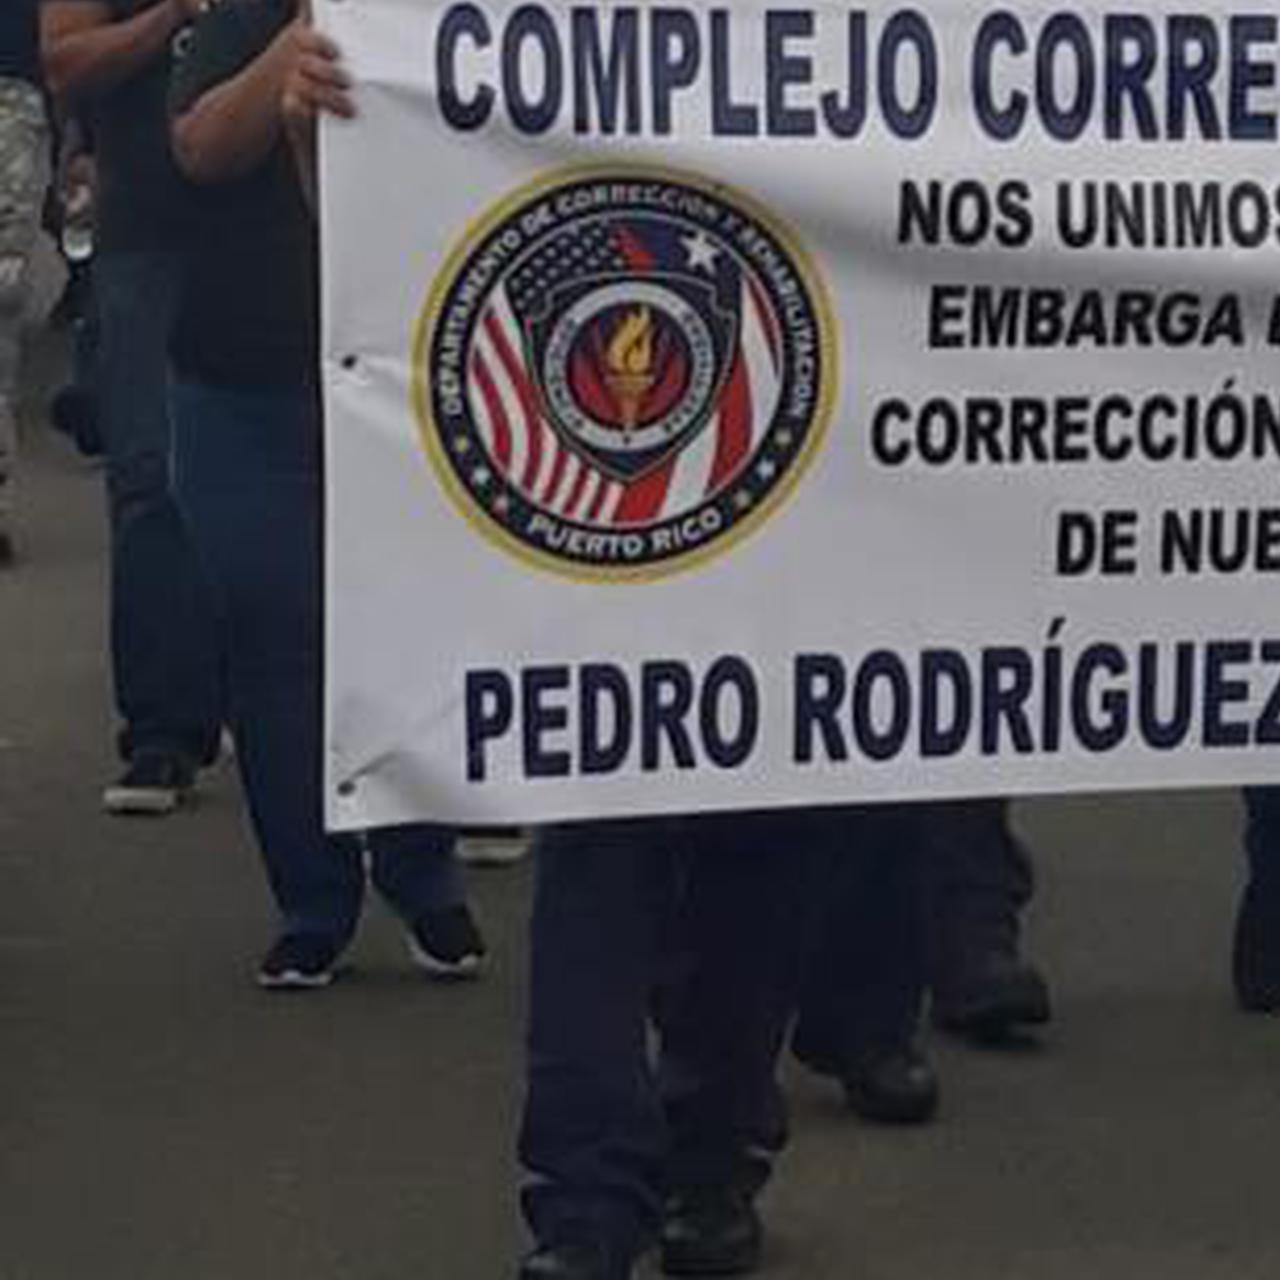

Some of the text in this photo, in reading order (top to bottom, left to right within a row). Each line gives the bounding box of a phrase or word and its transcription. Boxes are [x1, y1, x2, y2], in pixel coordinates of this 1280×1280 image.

[436, 2, 938, 140] COMPLEJO
[897, 179, 1034, 248] NOS
[927, 284, 1245, 349] EMBARGA
[527, 505, 723, 558] PUERTO RICO
[1055, 509, 1138, 576] DE
[464, 655, 760, 782] PEDRO
